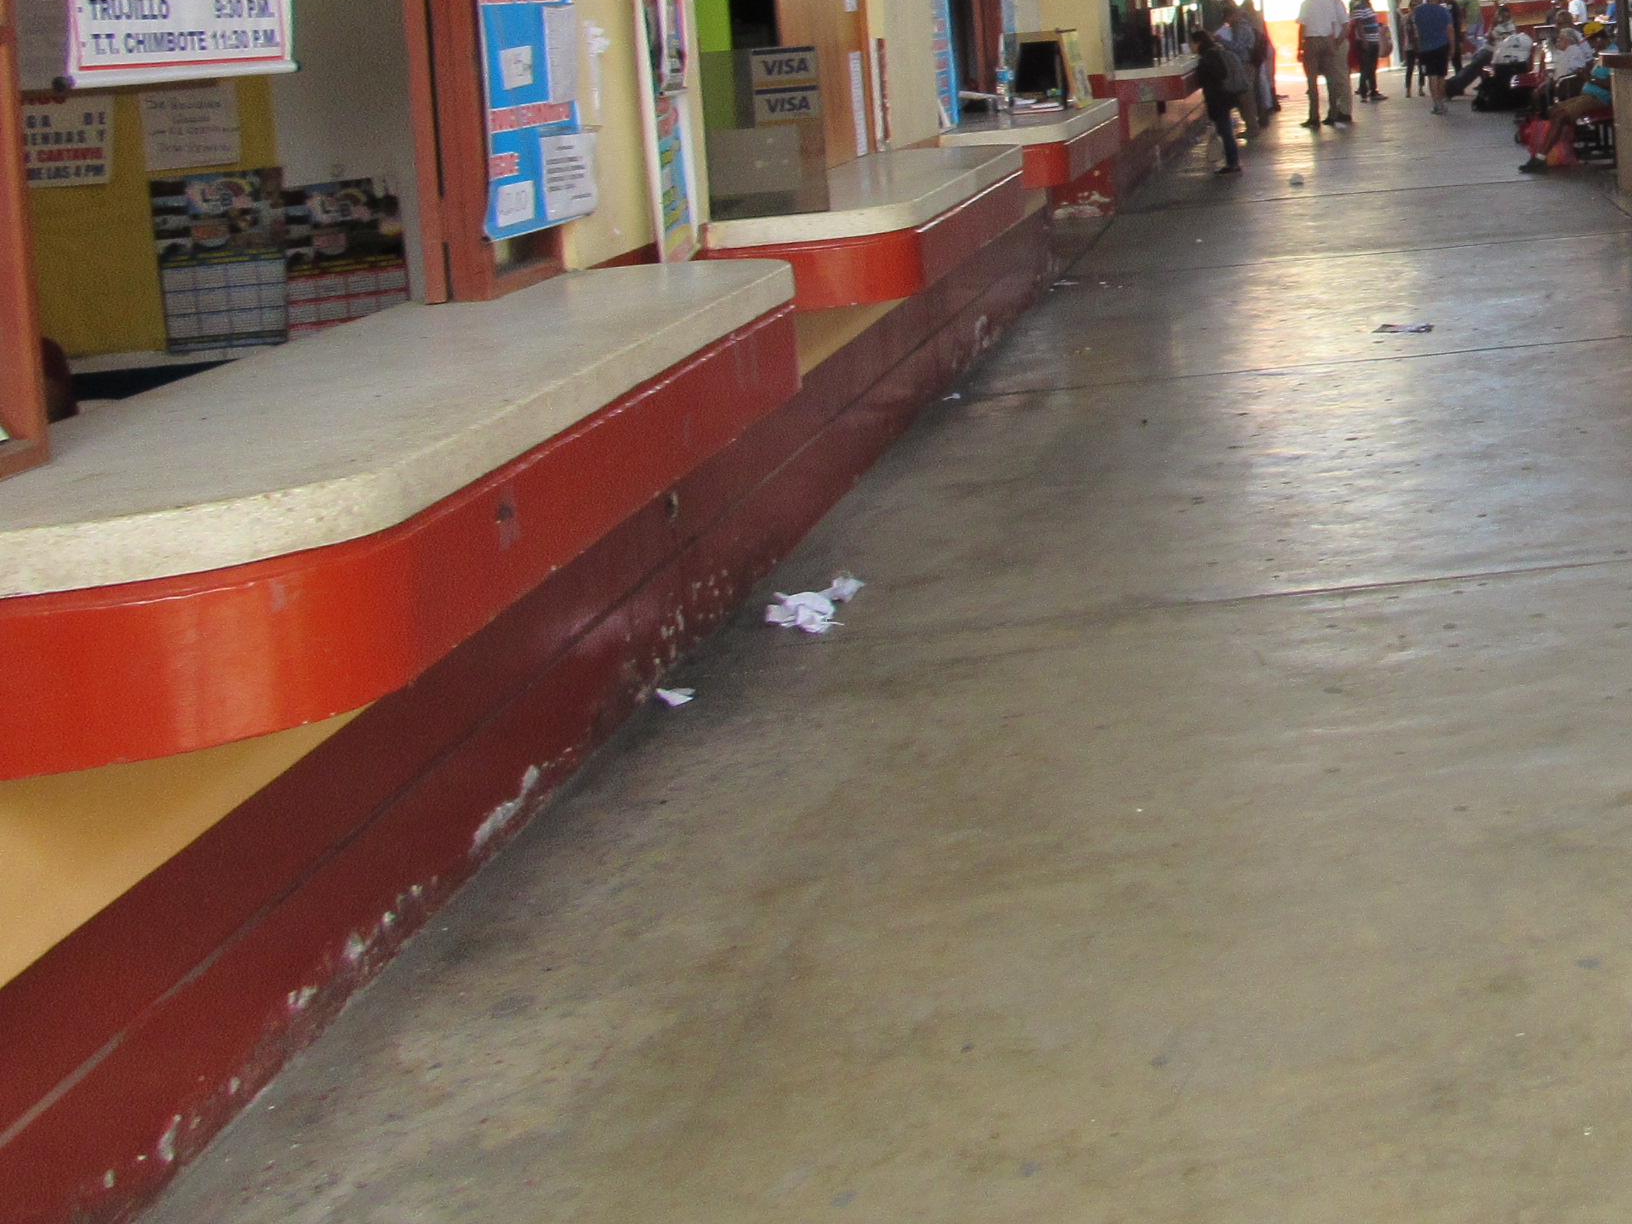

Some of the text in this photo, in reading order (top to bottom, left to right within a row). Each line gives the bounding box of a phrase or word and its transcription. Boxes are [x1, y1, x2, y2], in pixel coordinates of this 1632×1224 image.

[88, 0, 170, 20] TRUJILLO
[124, 30, 207, 54] CHIMBOTE
[761, 58, 809, 76] VISA
[766, 95, 811, 113] VISA
